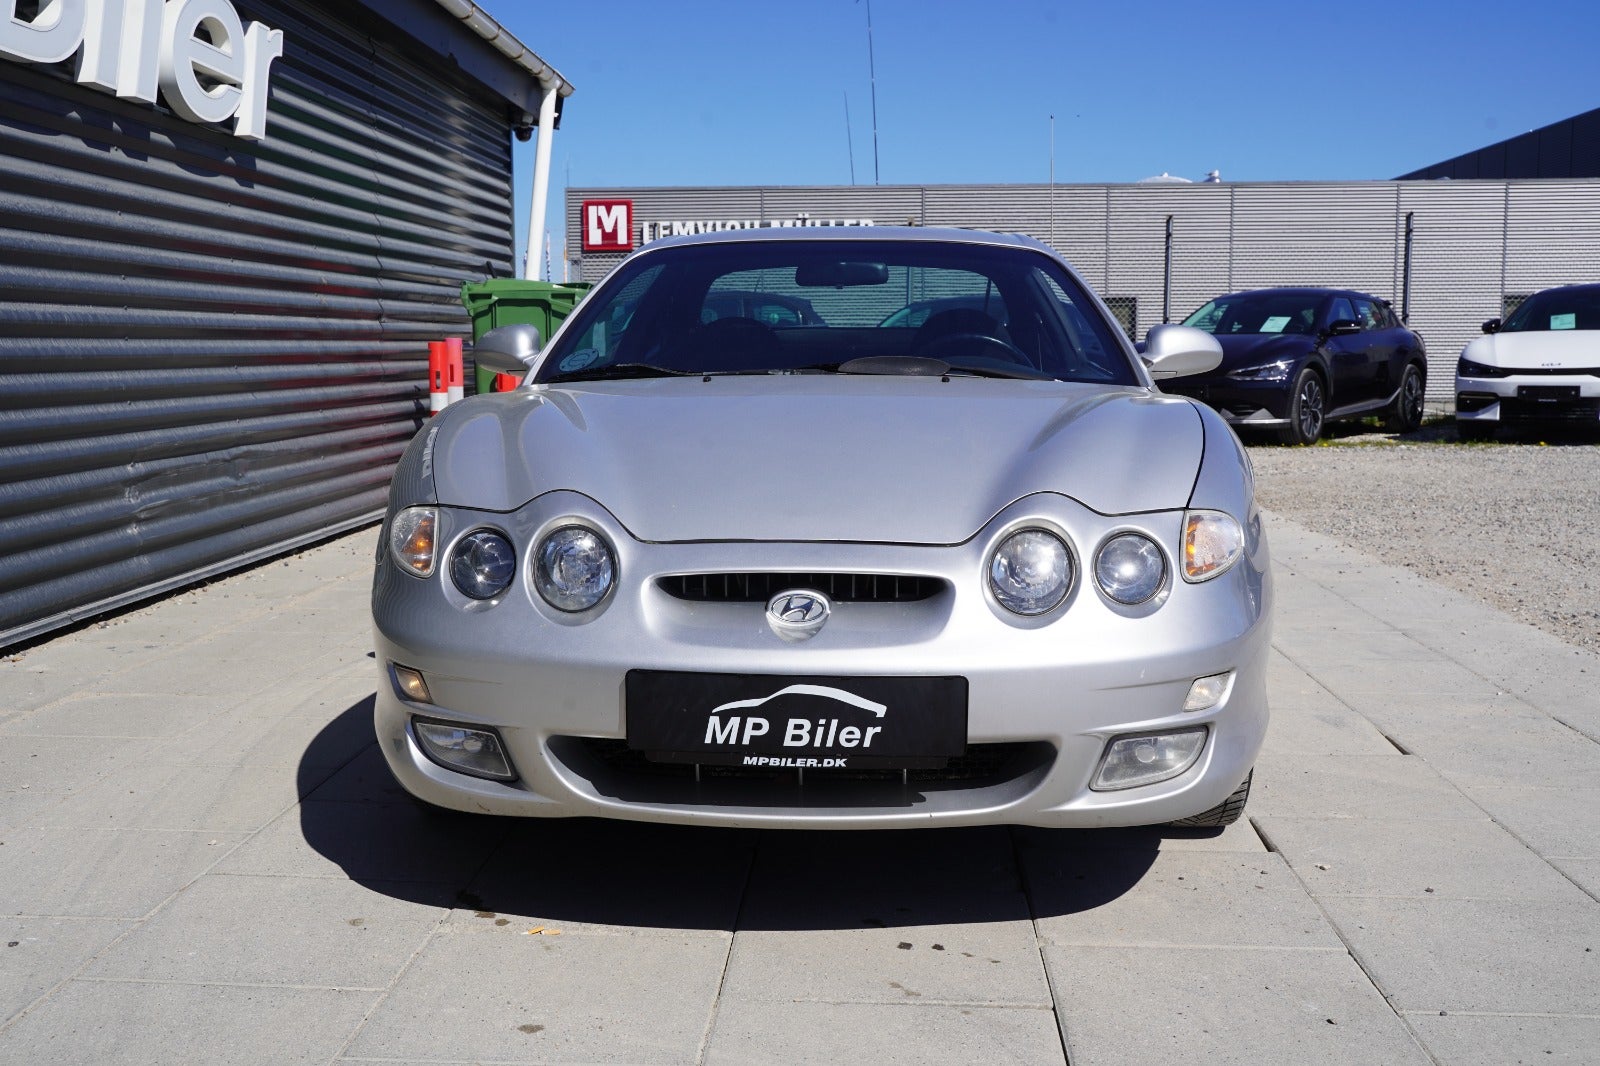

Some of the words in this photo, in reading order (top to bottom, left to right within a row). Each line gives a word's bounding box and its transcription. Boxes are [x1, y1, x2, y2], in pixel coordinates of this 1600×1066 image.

[704, 715, 769, 745] MP
[783, 718, 881, 748] Biler
[743, 756, 847, 768] MPBILER.DK
